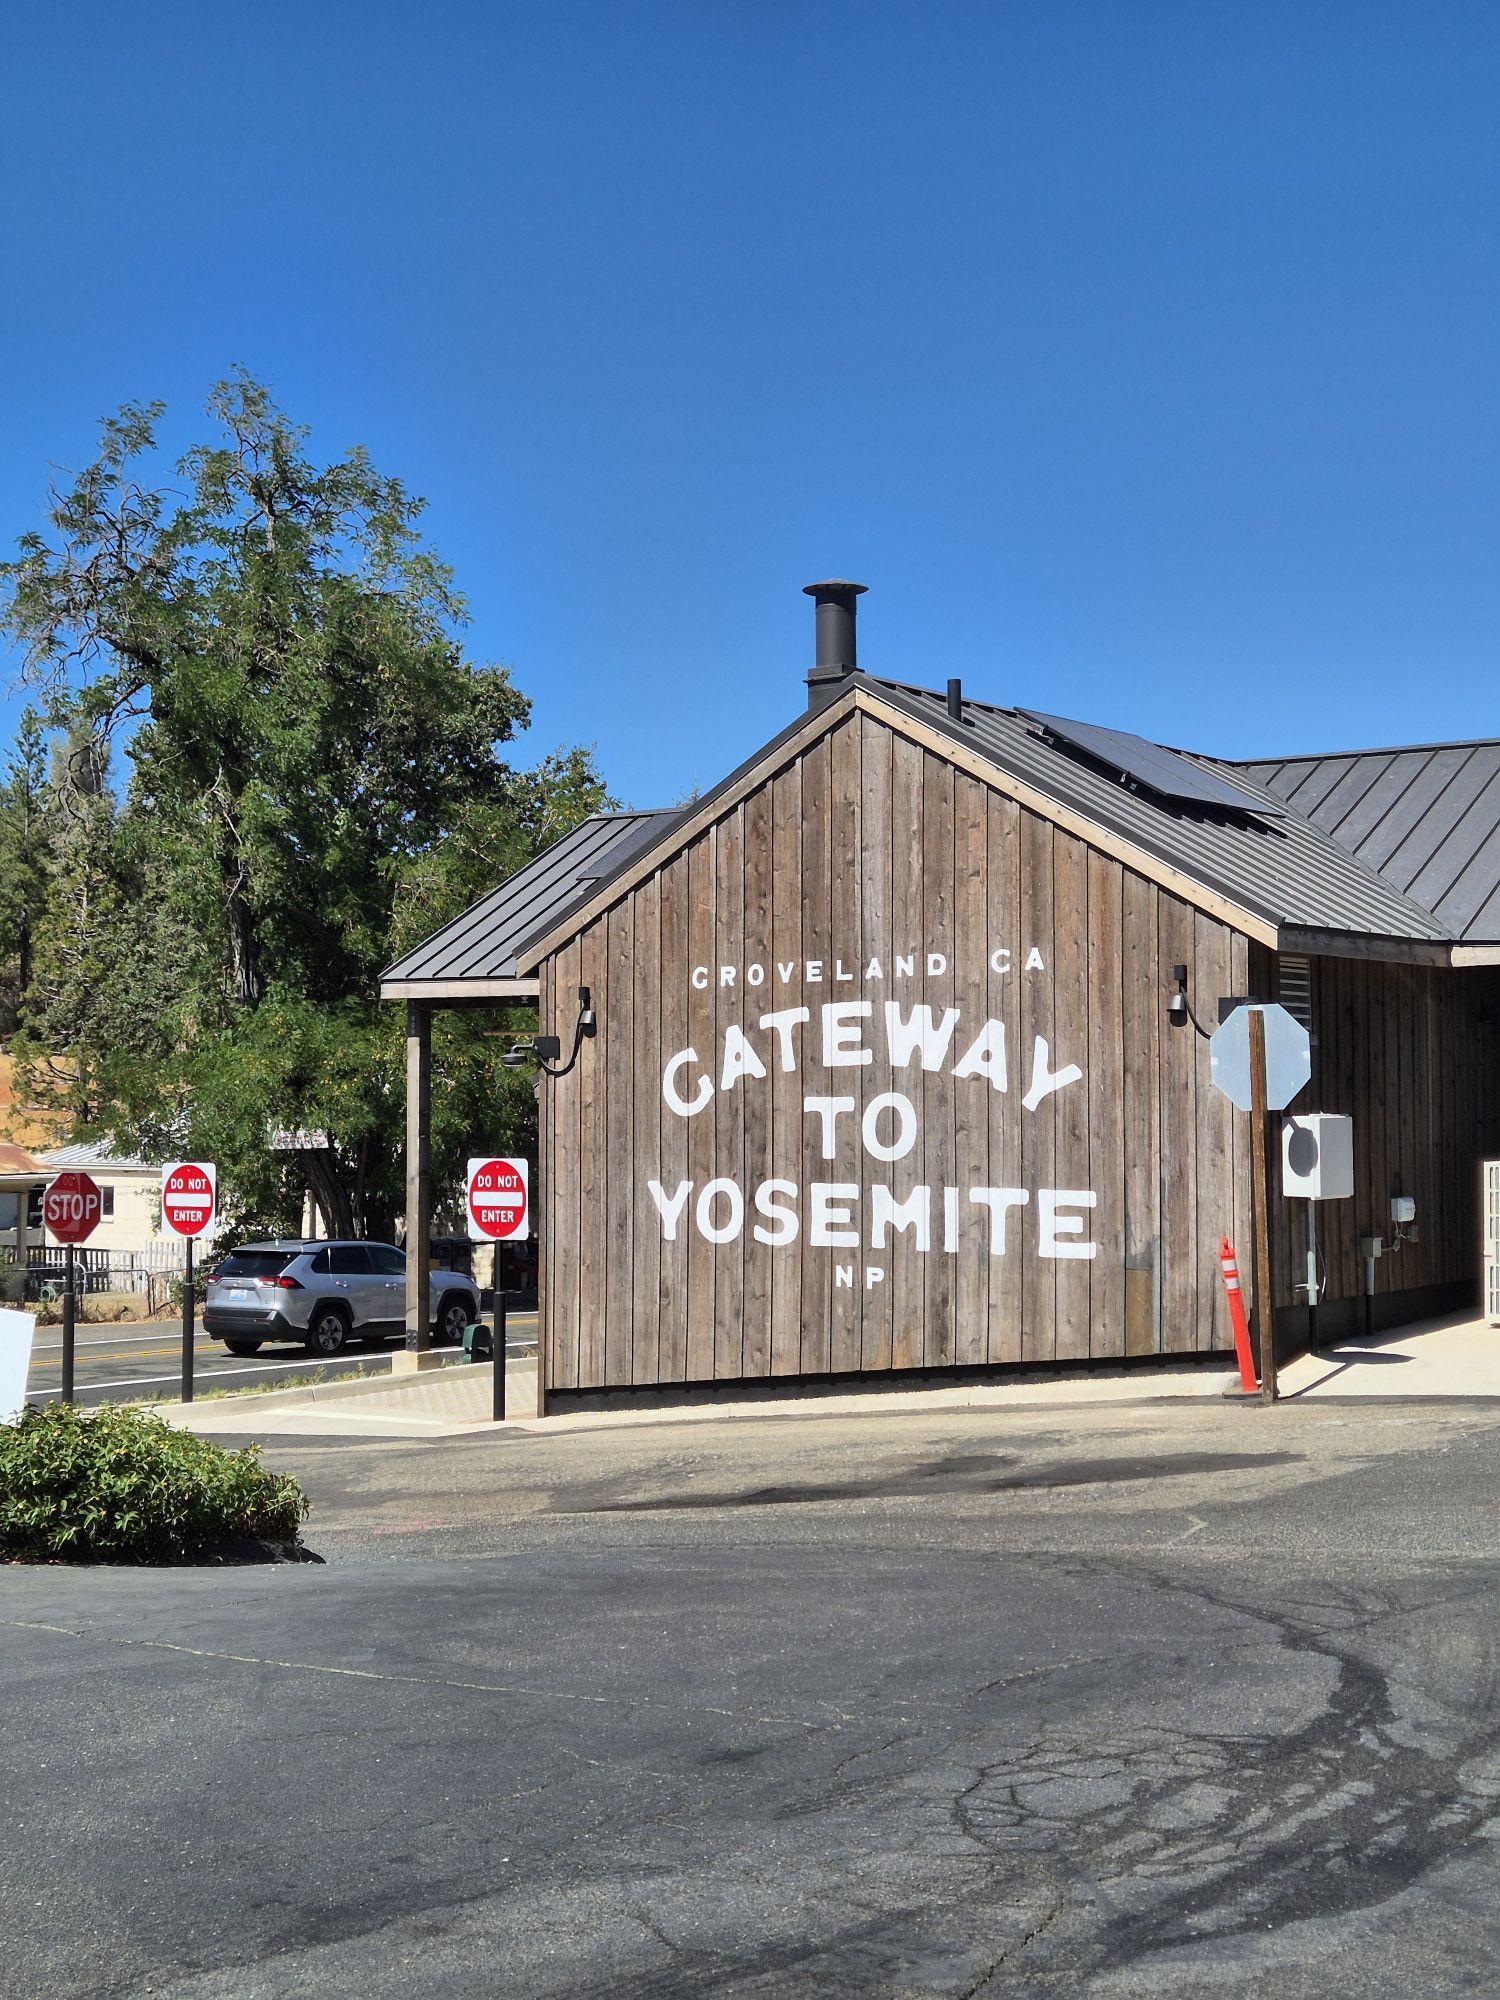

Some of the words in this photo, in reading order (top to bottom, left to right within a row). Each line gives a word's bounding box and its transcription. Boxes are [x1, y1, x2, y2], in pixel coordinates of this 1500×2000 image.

[691, 952, 947, 990] GROVELAND
[990, 946, 1045, 974] CA
[662, 1000, 1083, 1118] GATEWAY
[803, 1091, 918, 1162] TO
[170, 1177, 184, 1190] DO
[187, 1178, 207, 1190] NOT
[477, 1174, 492, 1188] DO
[497, 1175, 519, 1188] NOT
[47, 1194, 98, 1221] STOP
[173, 1210, 203, 1222] ENTER
[481, 1209, 514, 1223] ENTER
[647, 1177, 1098, 1260] YOSEMITE
